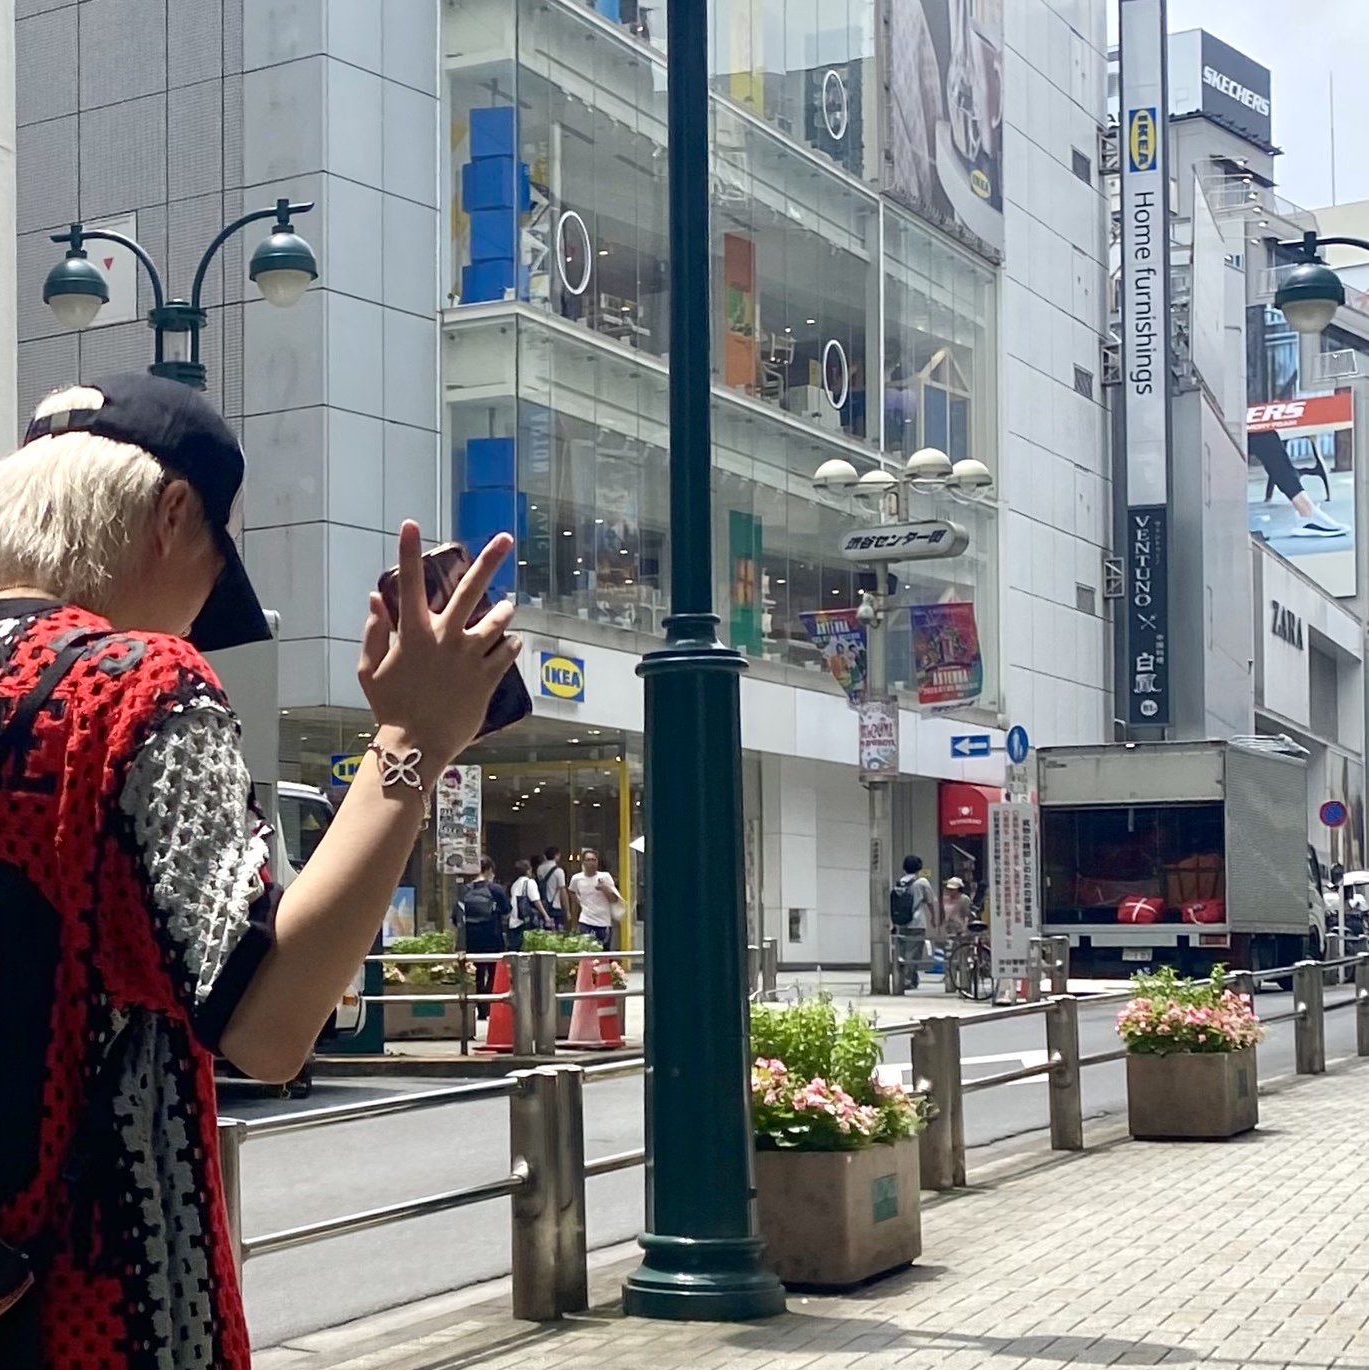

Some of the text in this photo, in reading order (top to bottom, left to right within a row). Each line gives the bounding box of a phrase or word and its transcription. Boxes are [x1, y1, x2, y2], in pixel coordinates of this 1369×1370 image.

[1203, 66, 1270, 117] SKECHERS
[1137, 115, 1149, 166] IKEA
[1130, 191, 1157, 396] Home furnishings
[1134, 515, 1152, 607] VENTUNO
[1271, 600, 1304, 651] ZARA
[545, 665, 581, 689] IKEA
